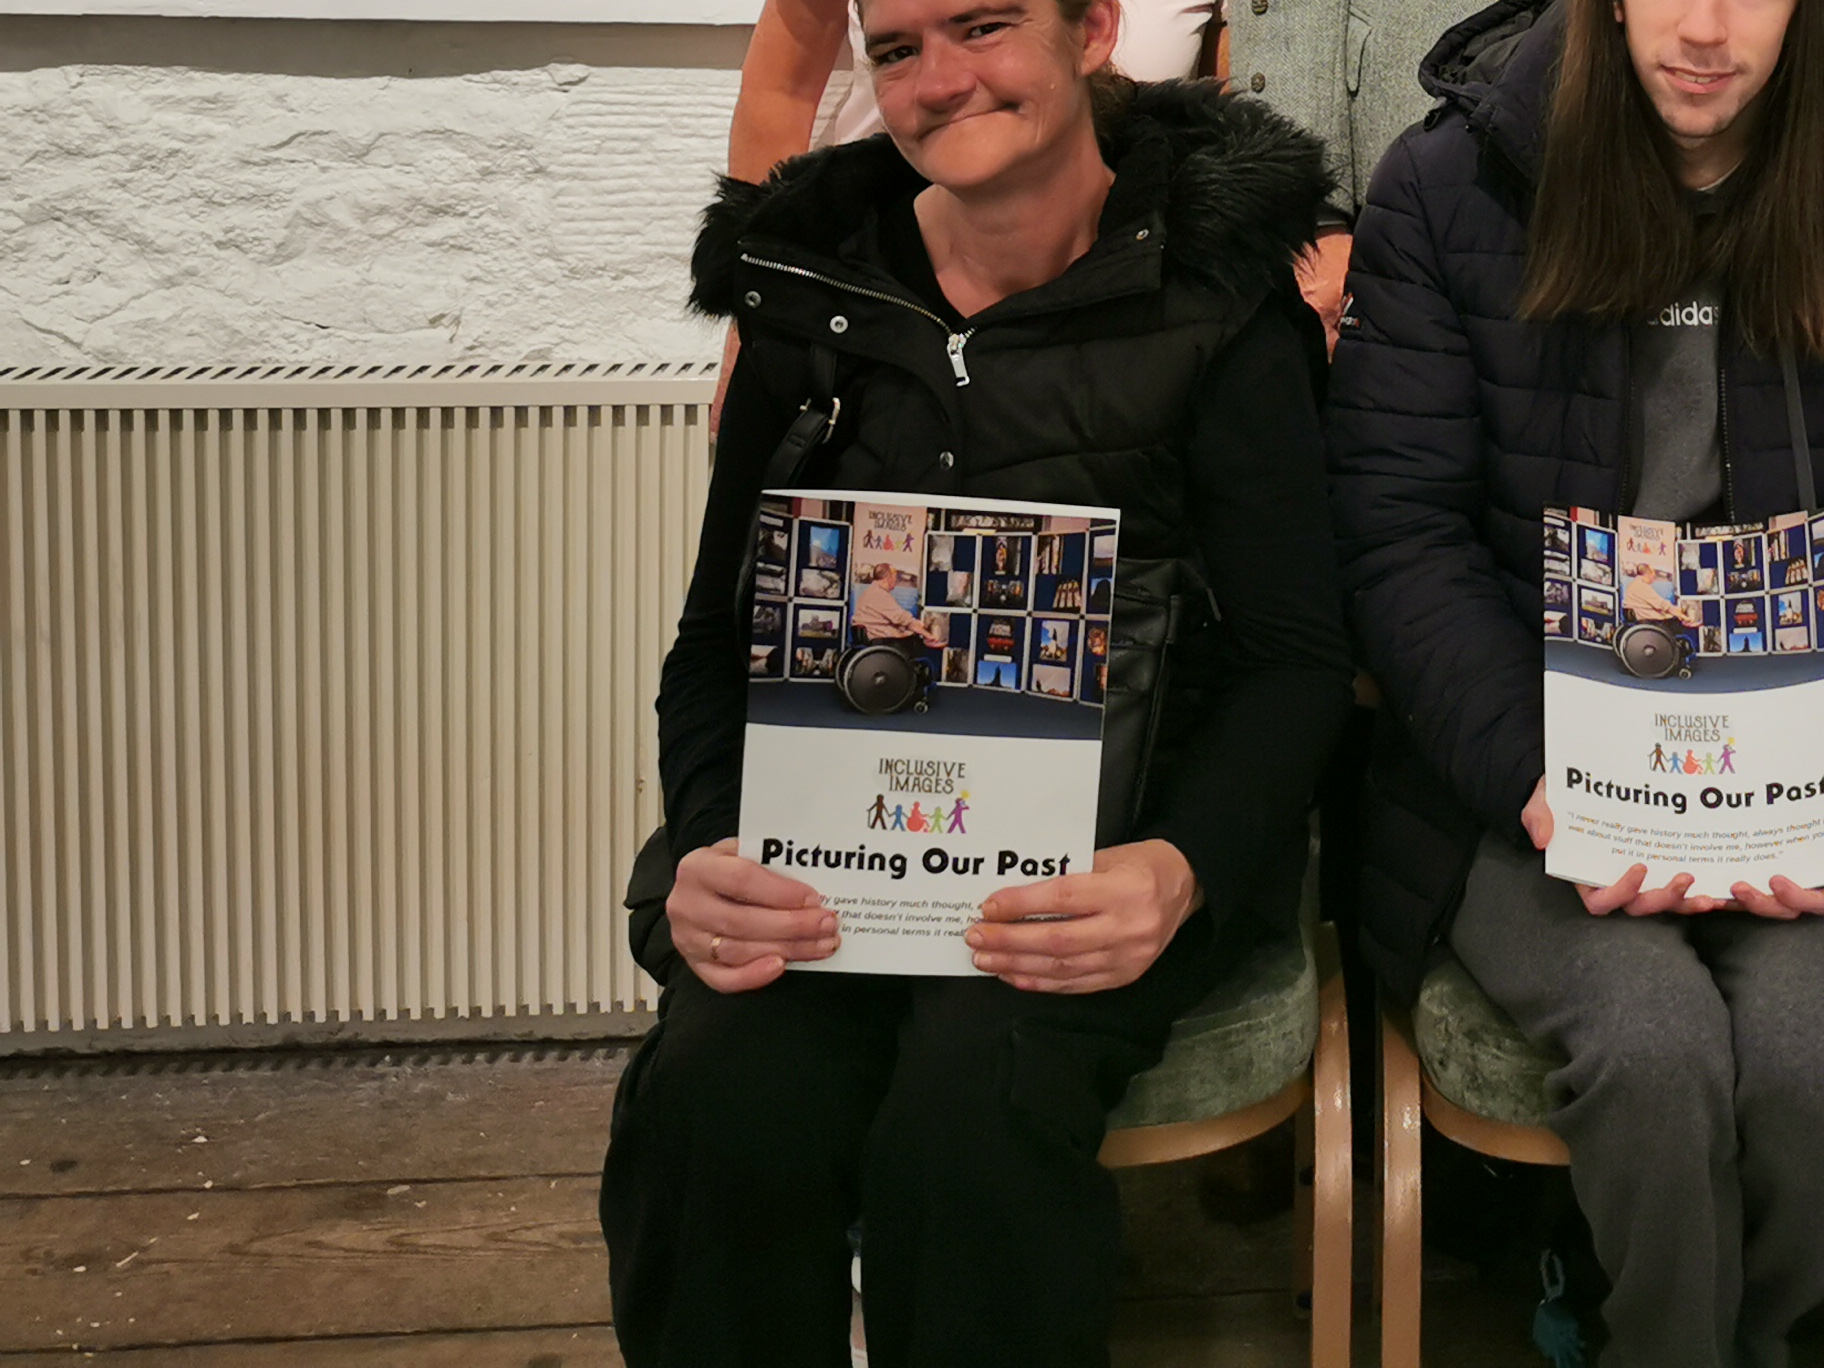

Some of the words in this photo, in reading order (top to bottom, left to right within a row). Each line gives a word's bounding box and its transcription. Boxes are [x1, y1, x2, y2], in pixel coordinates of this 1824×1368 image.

[1647, 301, 1719, 327] dida
[1654, 713, 1730, 730] INCLUSIVE
[1664, 727, 1720, 743] IMAGES
[878, 757, 966, 779] INCLUSIVE
[888, 776, 955, 795] IMAGES
[1566, 766, 1689, 814] Picturing
[1700, 787, 1755, 809] Our
[1602, 820, 1625, 832] really
[1627, 826, 1648, 835] gave
[1650, 828, 1682, 839] history
[1684, 831, 1709, 839] much
[1712, 830, 1749, 840] thought,
[1752, 827, 1784, 837] always
[1787, 819, 1821, 832] thought
[1587, 829, 1611, 840] about
[1613, 835, 1633, 844] stuff
[1635, 839, 1652, 847] that
[1690, 843, 1723, 851] involve
[1745, 839, 1784, 850] however
[1786, 835, 1810, 845] when
[762, 837, 908, 878] Picturing
[922, 847, 985, 876] Our
[997, 850, 1071, 877] Past
[1611, 847, 1626, 855] put
[1646, 852, 1687, 863] personal
[1688, 856, 1715, 864] terms
[1725, 854, 1751, 864] really
[834, 897, 858, 906] gave
[861, 897, 897, 908] history
[900, 900, 928, 909] much
[932, 900, 974, 911] thought,
[842, 910, 861, 919] that
[864, 911, 903, 922] doesn't
[905, 913, 943, 923] involve
[945, 916, 963, 925] me,
[842, 924, 851, 933] in
[853, 926, 899, 939] personal
[902, 928, 931, 937] terms
[934, 928, 941, 937] it
[943, 929, 967, 938] reall
